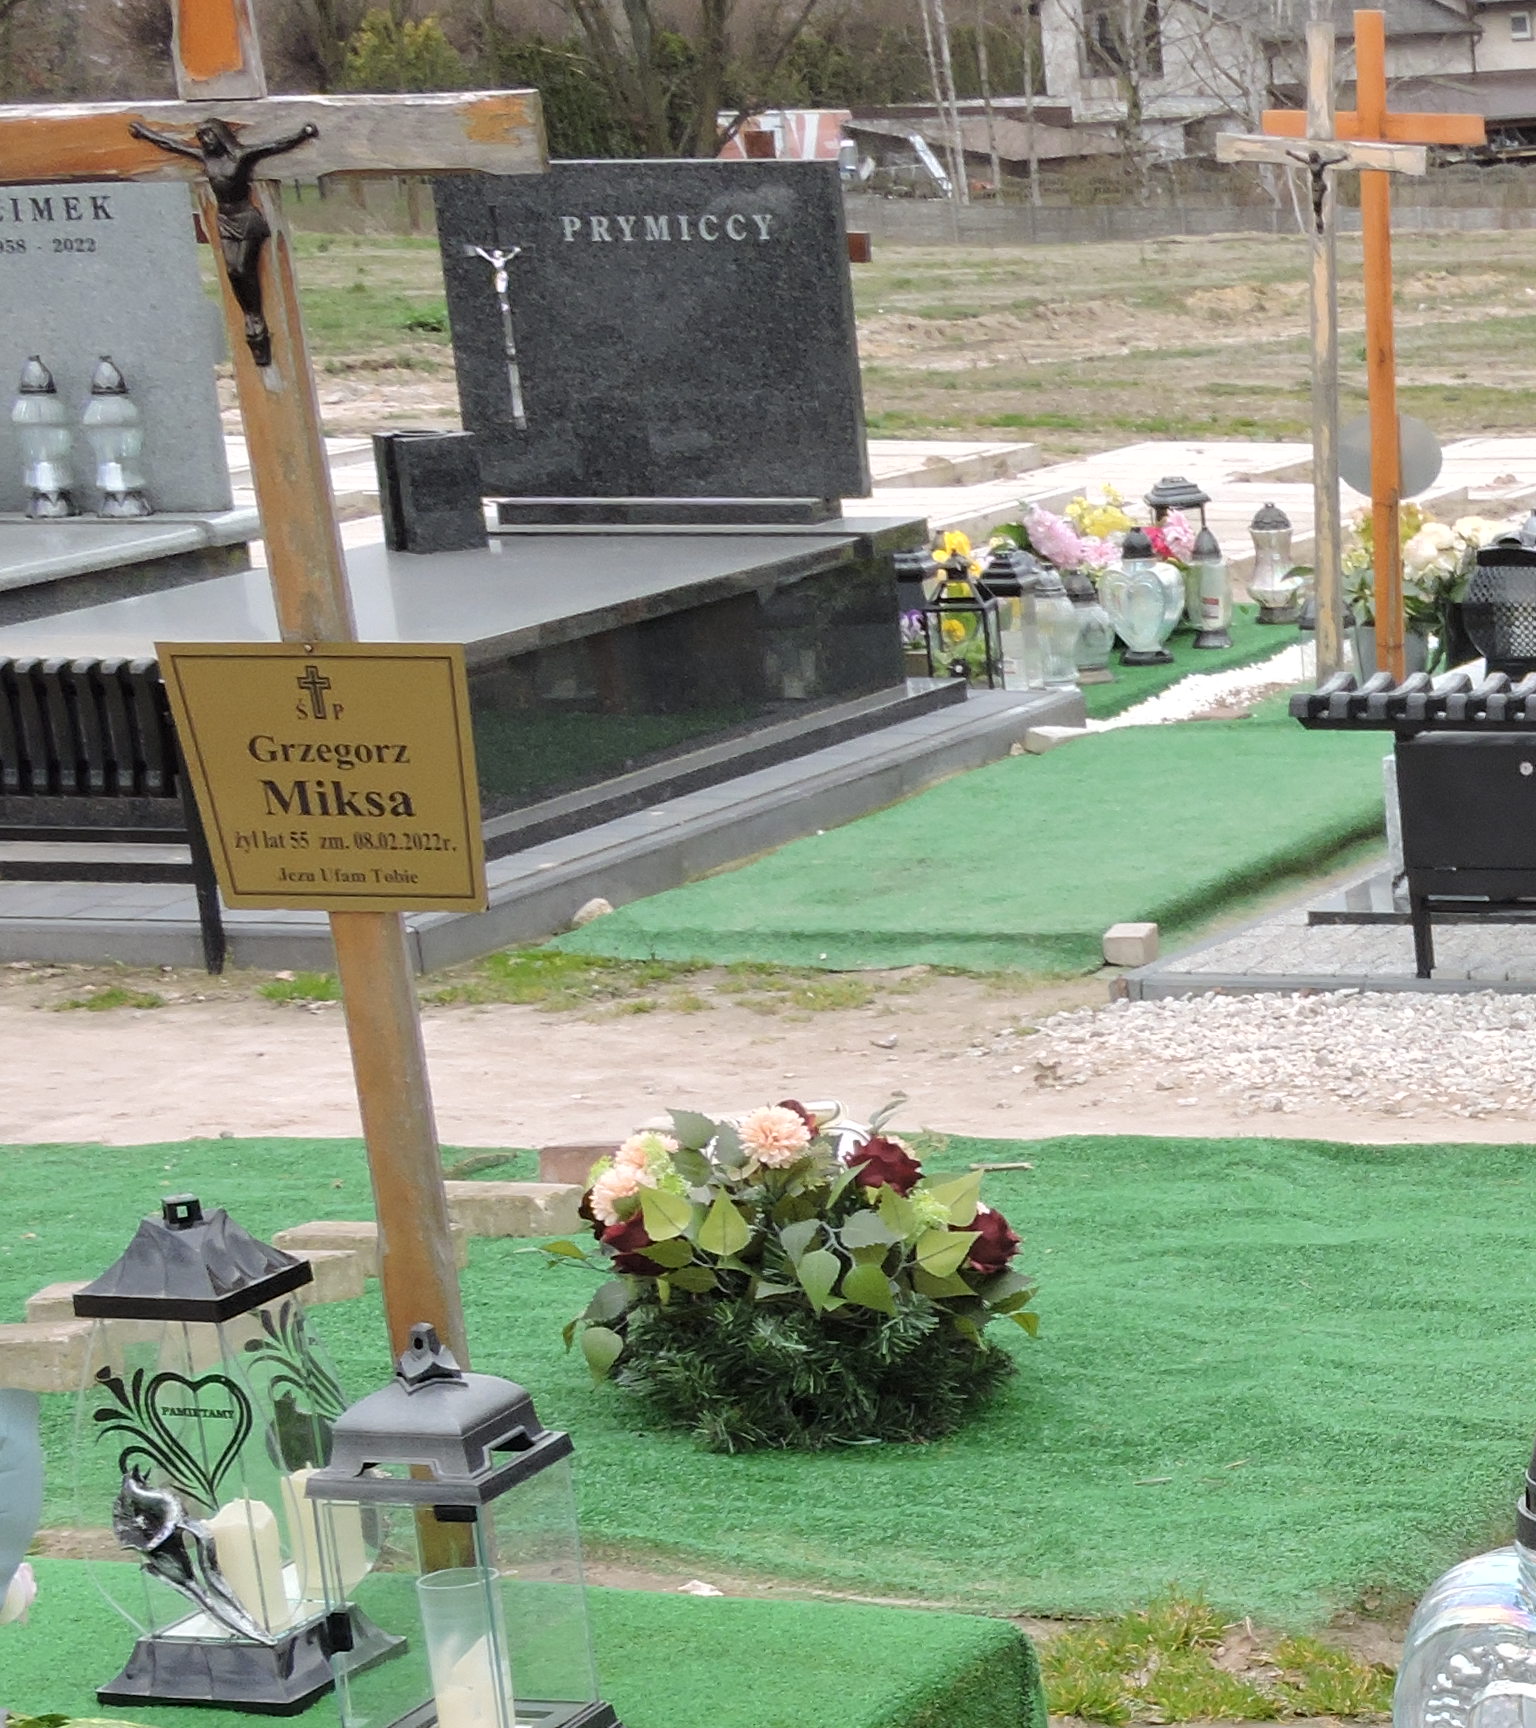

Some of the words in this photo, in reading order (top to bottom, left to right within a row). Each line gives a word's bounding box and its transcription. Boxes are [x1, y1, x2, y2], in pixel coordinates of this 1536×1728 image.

[0, 196, 114, 222] IMEK
[560, 214, 773, 242] PRYMICCY
[52, 238, 97, 254] 2022
[248, 735, 411, 771] Grzegorz
[259, 779, 417, 818] Miksa
[262, 831, 286, 850] lat
[289, 831, 310, 850] 55
[278, 866, 316, 883] Jezu
[319, 867, 367, 884] Ufam
[371, 868, 419, 884] Tobie
